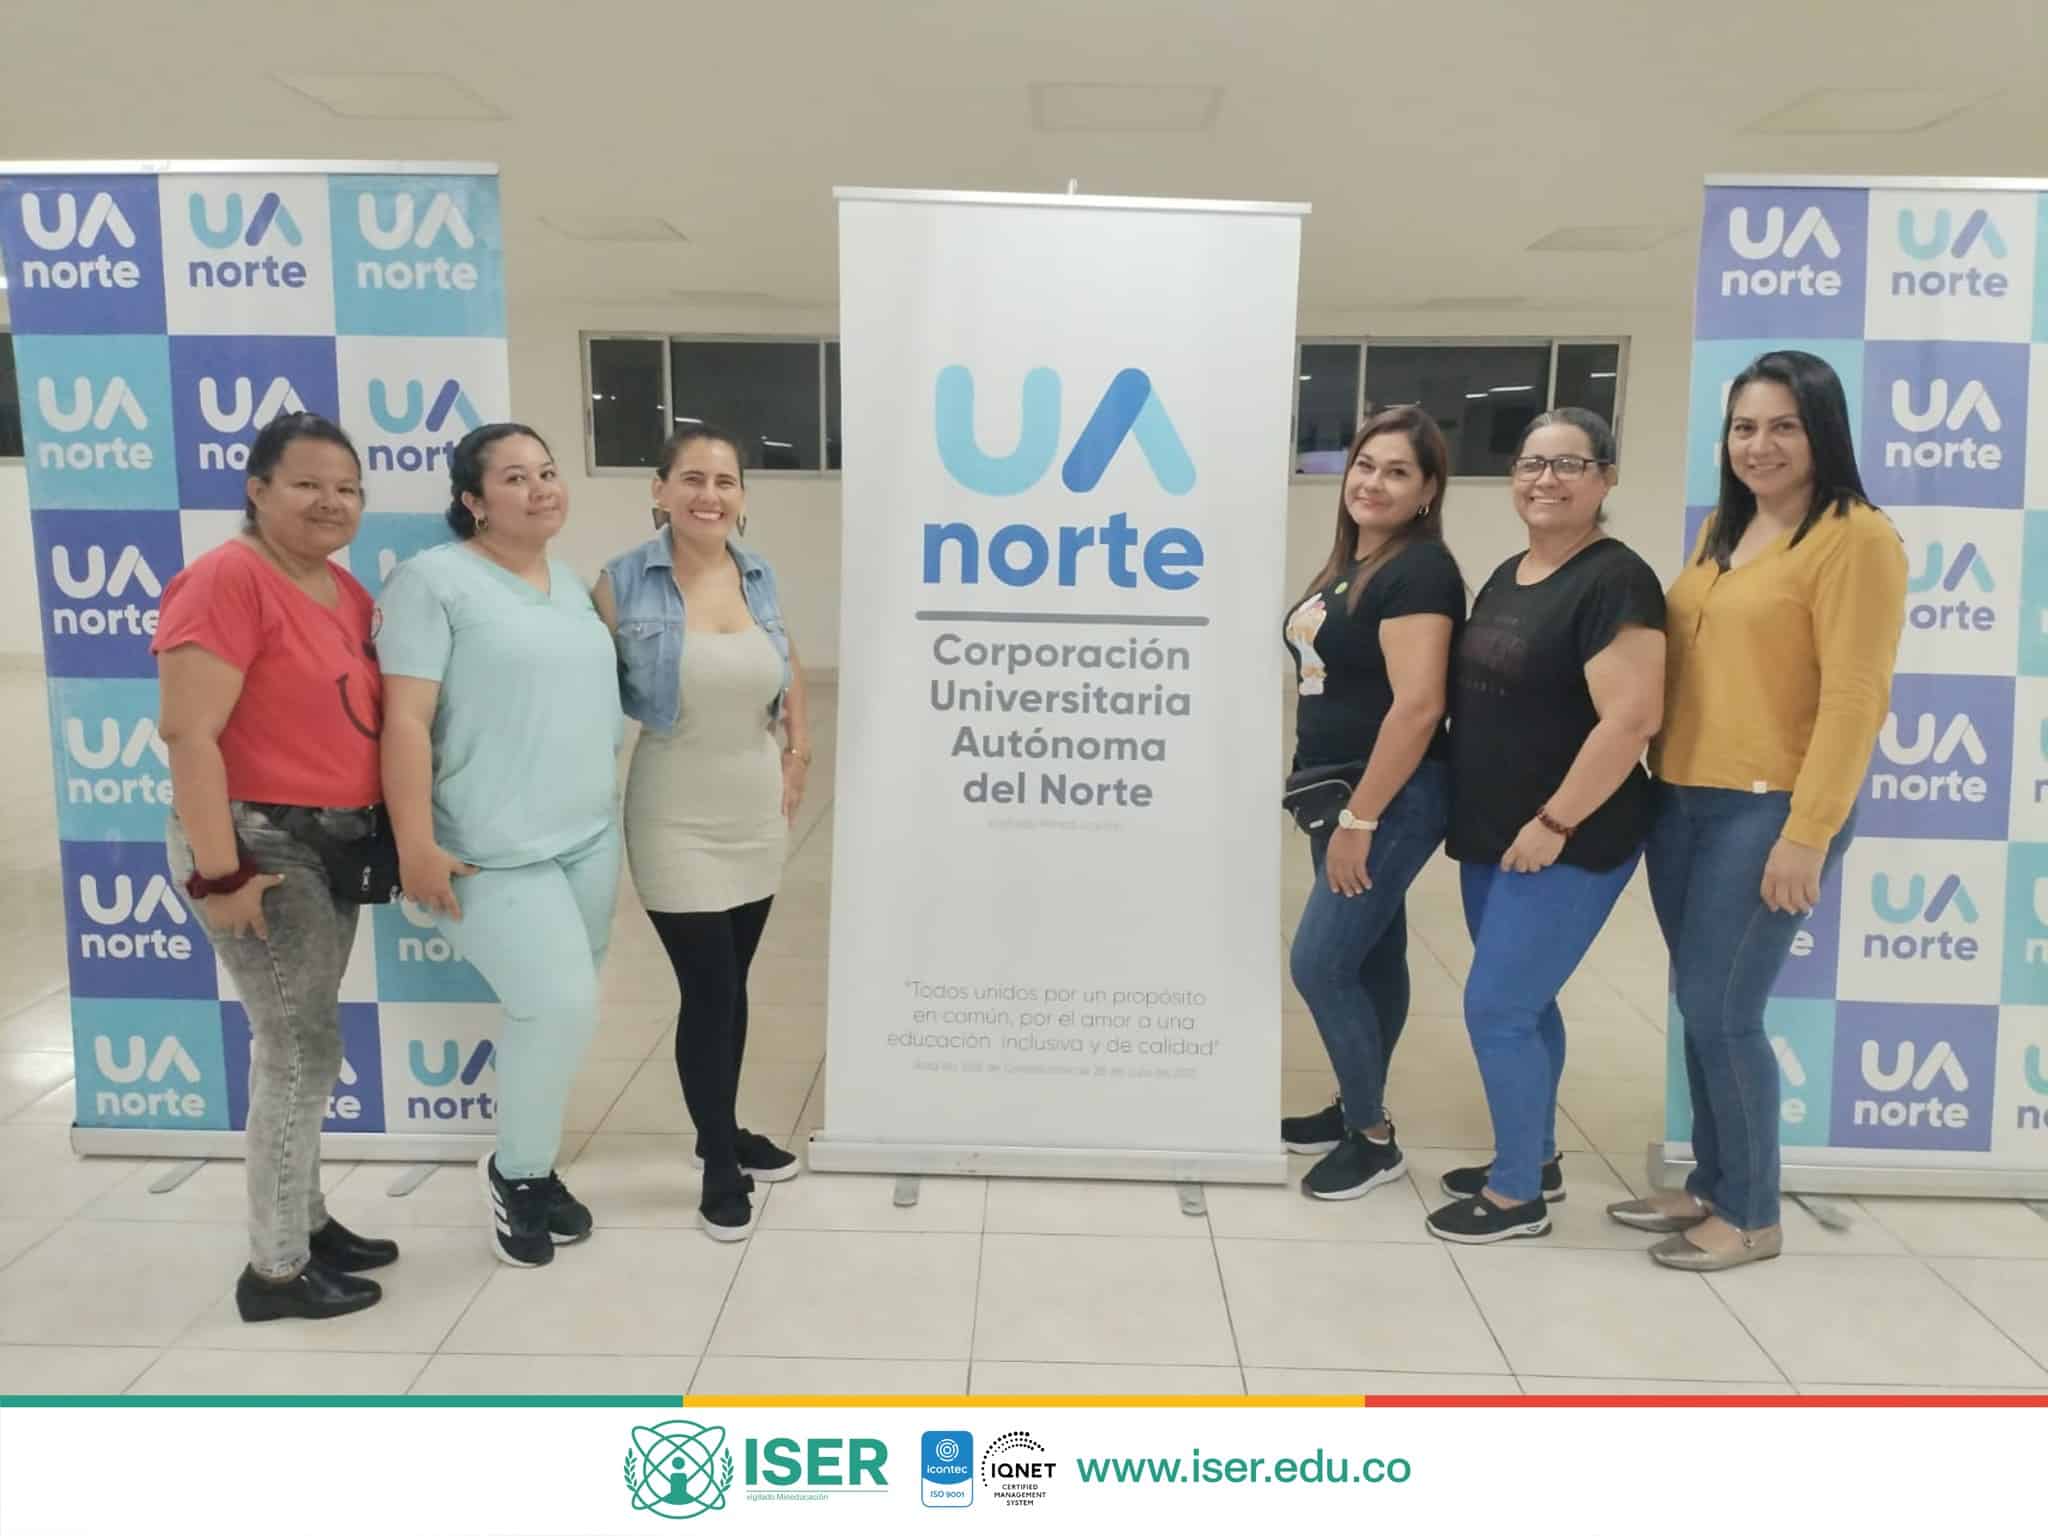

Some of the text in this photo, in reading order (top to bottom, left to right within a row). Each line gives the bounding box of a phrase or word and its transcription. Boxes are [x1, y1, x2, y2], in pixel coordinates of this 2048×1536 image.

[21, 192, 136, 250] UA
[188, 192, 303, 249] UA
[358, 192, 474, 250] UA
[1729, 206, 1841, 260] UA
[1898, 208, 2008, 260] UA
[22, 255, 140, 289] norte
[188, 255, 306, 289] norte
[356, 256, 478, 291] norte
[1721, 263, 1841, 297] norte
[1891, 264, 2009, 298] norte
[38, 376, 148, 432] UA
[1891, 378, 2001, 433] UA
[935, 364, 1197, 497] UA
[38, 436, 153, 470] norte
[368, 441, 455, 471] nort
[1885, 436, 2002, 470] norte
[923, 512, 1205, 591] norte
[52, 545, 162, 599] UA
[53, 604, 160, 635] norte
[1909, 600, 1996, 632] orte
[933, 633, 1191, 675] Corporación
[930, 679, 1192, 717] Universitaria
[951, 725, 1167, 762] Autónoma
[1879, 712, 1987, 765] UA
[68, 773, 173, 805] norte
[963, 772, 1153, 807] del Norte
[1871, 767, 1987, 803] norte
[80, 874, 187, 924] UA
[1871, 871, 1979, 924] UA
[80, 928, 193, 960] norte
[1863, 928, 1979, 962] norte
[974, 984, 1038, 1002] unidos
[1044, 988, 1078, 1006] por
[1083, 990, 1107, 1004] un
[1112, 988, 1207, 1008] propósito
[912, 1008, 1196, 1031] en común, por el amor a una
[95, 1035, 201, 1083] UA
[887, 1031, 991, 1049] educación
[1002, 1033, 1083, 1052] inclusiva
[1089, 1039, 1100, 1055] y
[1106, 1036, 1129, 1054] de
[1860, 1039, 1968, 1092] UA
[96, 1085, 206, 1117] norte
[408, 1092, 498, 1119] nort
[1853, 1096, 1968, 1130] norte
